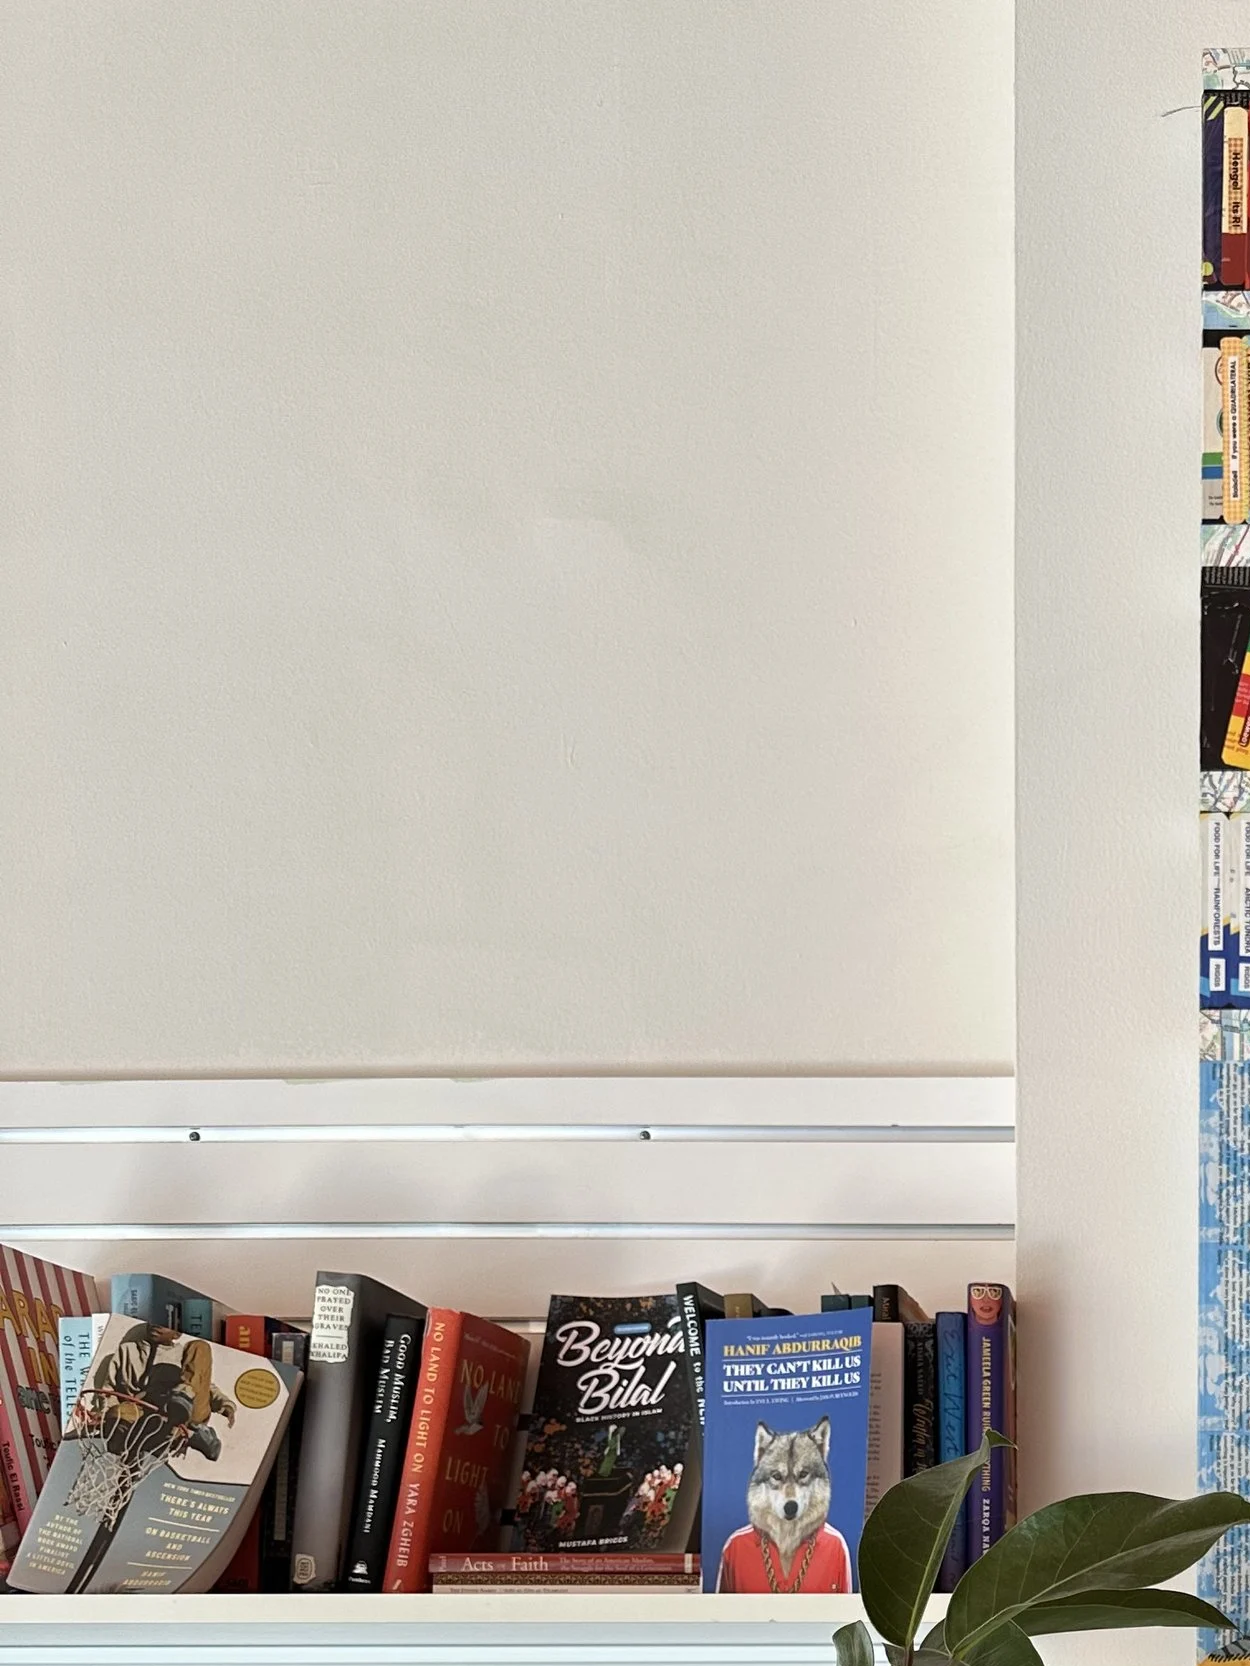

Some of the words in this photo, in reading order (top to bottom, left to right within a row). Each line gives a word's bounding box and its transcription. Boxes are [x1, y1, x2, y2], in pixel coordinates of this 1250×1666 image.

[317, 1287, 331, 1297] NO
[317, 1296, 351, 1306] PRAYED
[317, 1314, 345, 1324] THEIR
[320, 1305, 344, 1315] OVER
[432, 1321, 445, 1344] NO
[555, 1315, 686, 1371] Beyond
[310, 1351, 349, 1360] KHALIFA
[311, 1342, 348, 1352] KHALED
[380, 1339, 396, 1365] BAD
[399, 1334, 412, 1370] GOOD
[723, 1343, 770, 1358] HANIF
[772, 1335, 863, 1356] ABDURRAQIB
[981, 1336, 991, 1379] JAMEELA
[426, 1345, 441, 1383] LAND
[723, 1361, 766, 1378] THEY
[767, 1358, 811, 1376] CAN'T
[811, 1356, 844, 1372] KILL
[844, 1355, 862, 1369] US
[374, 1367, 391, 1414] MUSLIM
[576, 1360, 677, 1415] Bilal
[722, 1376, 771, 1394] UNTIL
[771, 1375, 810, 1391] THEY
[811, 1373, 844, 1388] KILL
[844, 1371, 861, 1385] US
[421, 1386, 436, 1405] TO
[981, 1379, 991, 1410] GREEN
[414, 1407, 433, 1449] LIGHT
[371, 1438, 387, 1487] MAHMOOD
[410, 1452, 426, 1474] ON
[363, 1488, 380, 1533] MAMDANI
[404, 1481, 421, 1517] YARA
[396, 1519, 413, 1568] ZGHEIB
[558, 1538, 597, 1549] MUSTAFA
[461, 1556, 494, 1571] Acts
[511, 1556, 549, 1571] Faith
